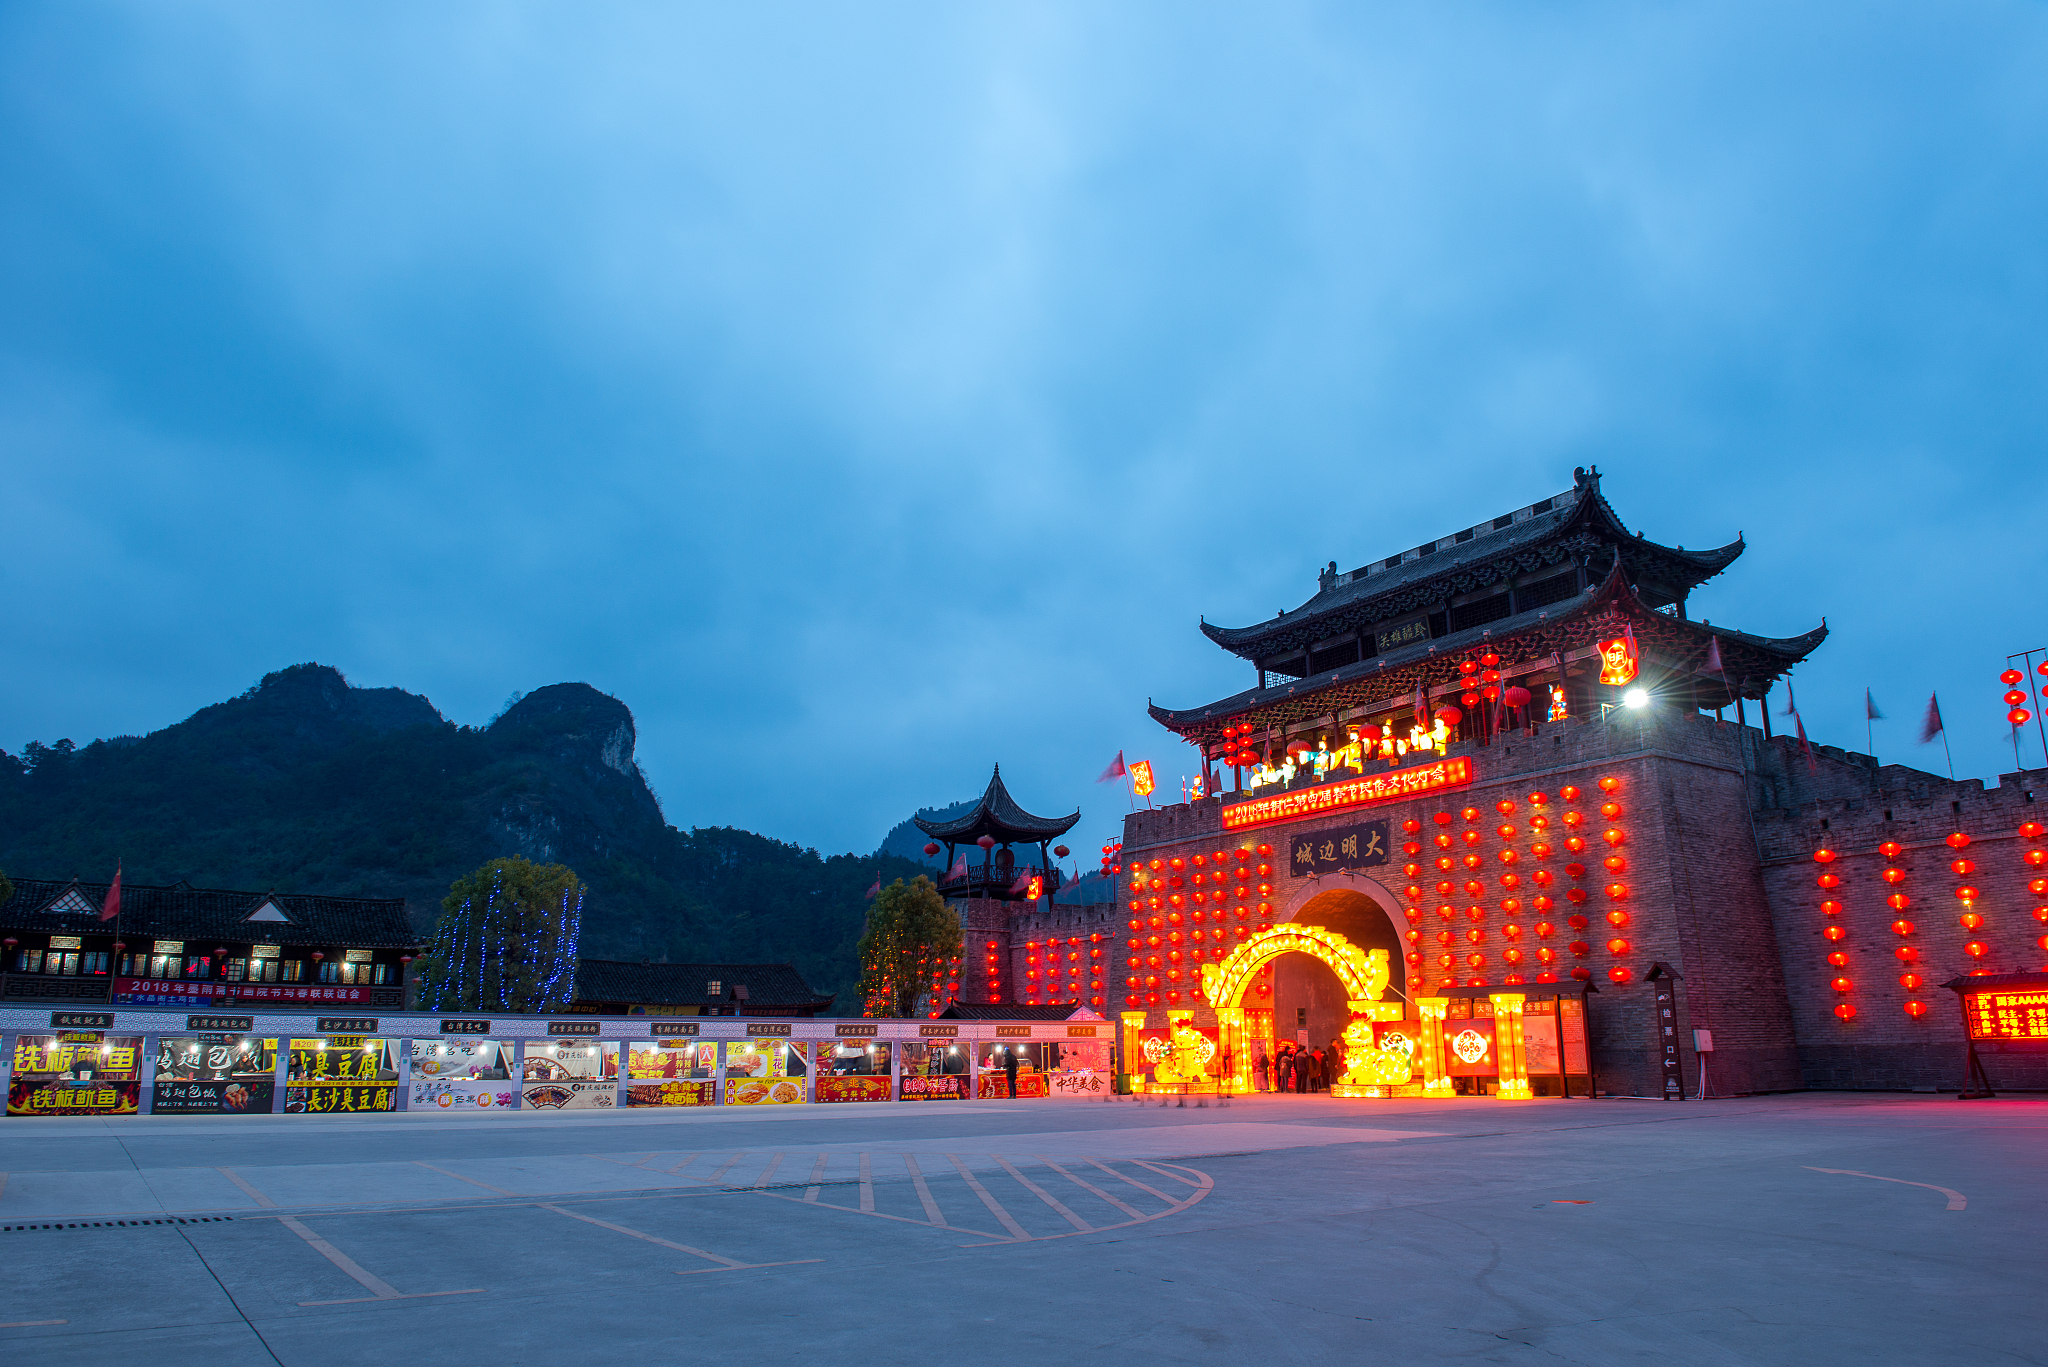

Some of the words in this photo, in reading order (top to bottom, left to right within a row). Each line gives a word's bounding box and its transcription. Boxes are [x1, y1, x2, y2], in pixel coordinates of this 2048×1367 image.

[1234, 767, 1446, 820] 2018年铜仁第四届春节民俗文化灯会
[60, 1015, 105, 1025] 铁板鱿鱼
[1662, 1008, 1674, 1054] 检票口
[160, 1084, 217, 1099] 鸡翅包饭
[1056, 1075, 1105, 1092] 中华美食
[32, 1089, 117, 1108] 铁板鱿鱼
[307, 1087, 389, 1112] 長沙臭豆腐
[661, 1092, 699, 1105] 烤面筋
